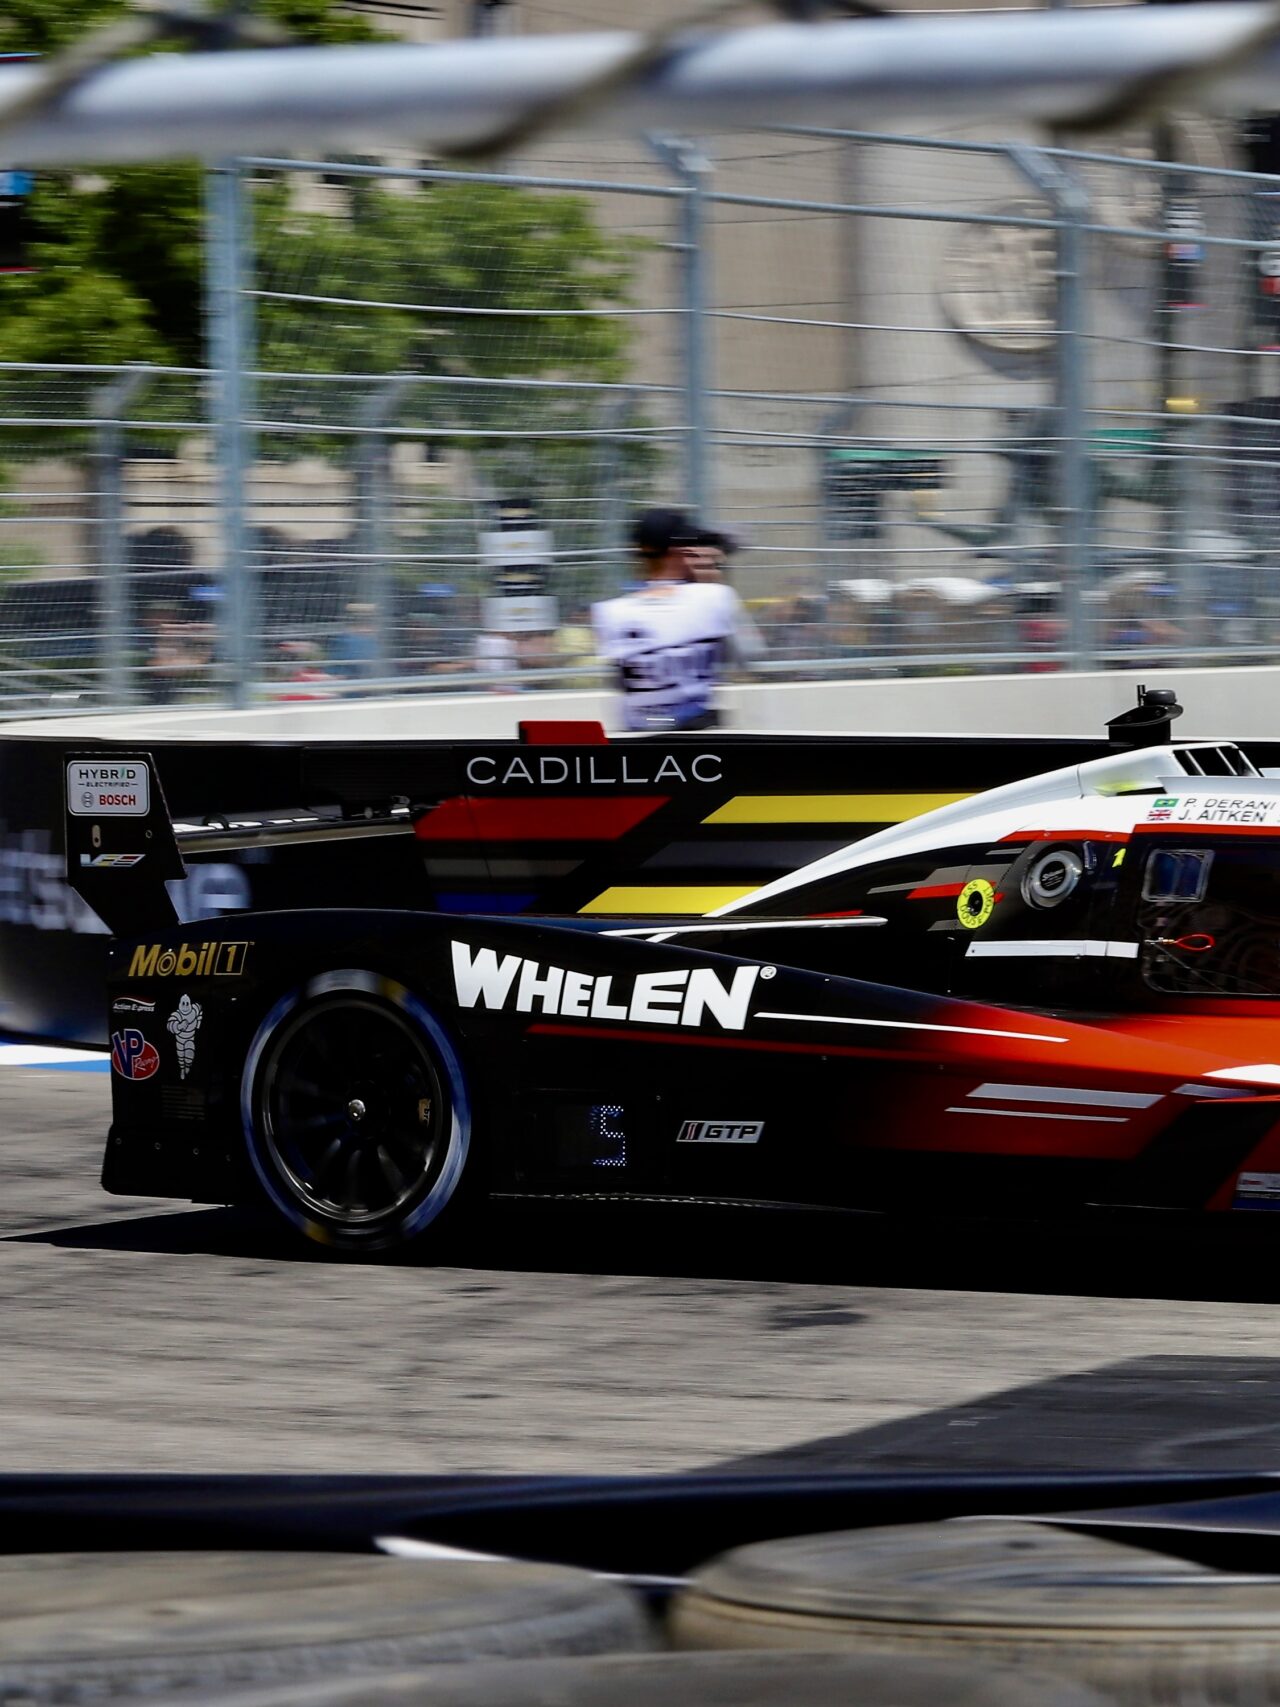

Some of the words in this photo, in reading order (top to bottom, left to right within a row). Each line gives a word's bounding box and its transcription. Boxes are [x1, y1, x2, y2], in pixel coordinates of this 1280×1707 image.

[79, 768, 137, 780] HYBRID
[466, 754, 723, 785] CADILLAC
[99, 794, 137, 806] BOSCH
[1204, 798, 1277, 811] DERANI
[1199, 809, 1268, 823] AITKEN
[128, 941, 217, 977] Mobil
[111, 1028, 146, 1079] VP
[704, 1124, 758, 1140] GTP
